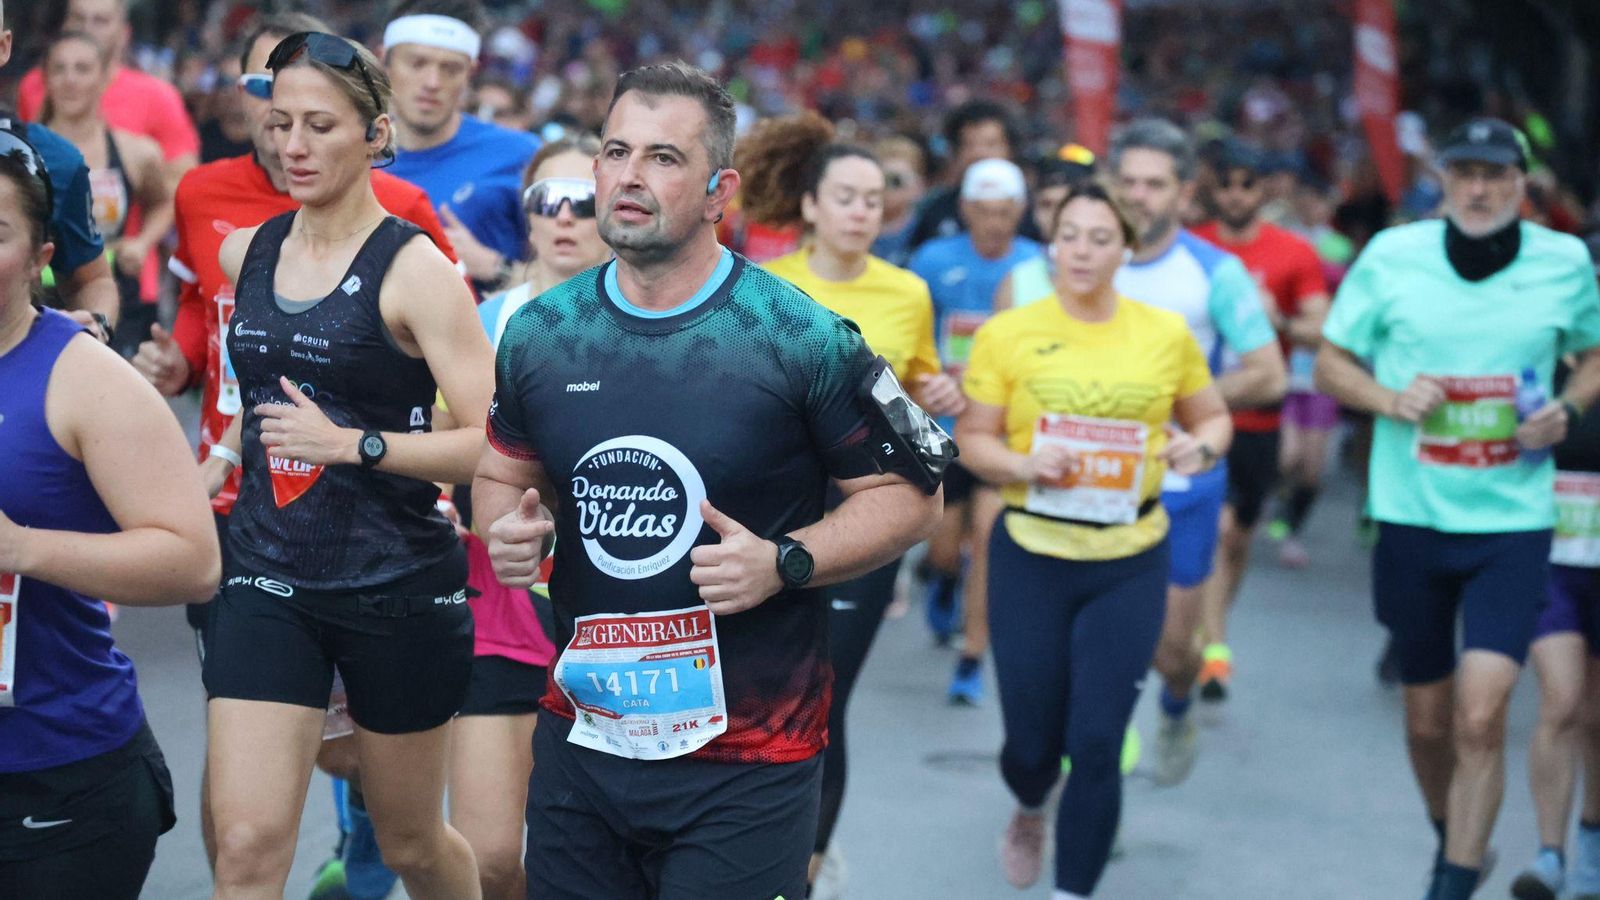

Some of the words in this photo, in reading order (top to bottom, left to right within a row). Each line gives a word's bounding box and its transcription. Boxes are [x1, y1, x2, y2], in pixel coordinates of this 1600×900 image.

[302, 335, 329, 348] CRUIN
[566, 380, 600, 392] mobel
[591, 449, 659, 471] FUNDACIÓN
[571, 476, 679, 502] Donando
[576, 500, 677, 538] Vidas
[586, 667, 679, 697] 14171
[622, 699, 650, 708] CATA
[672, 719, 699, 733] 21K
